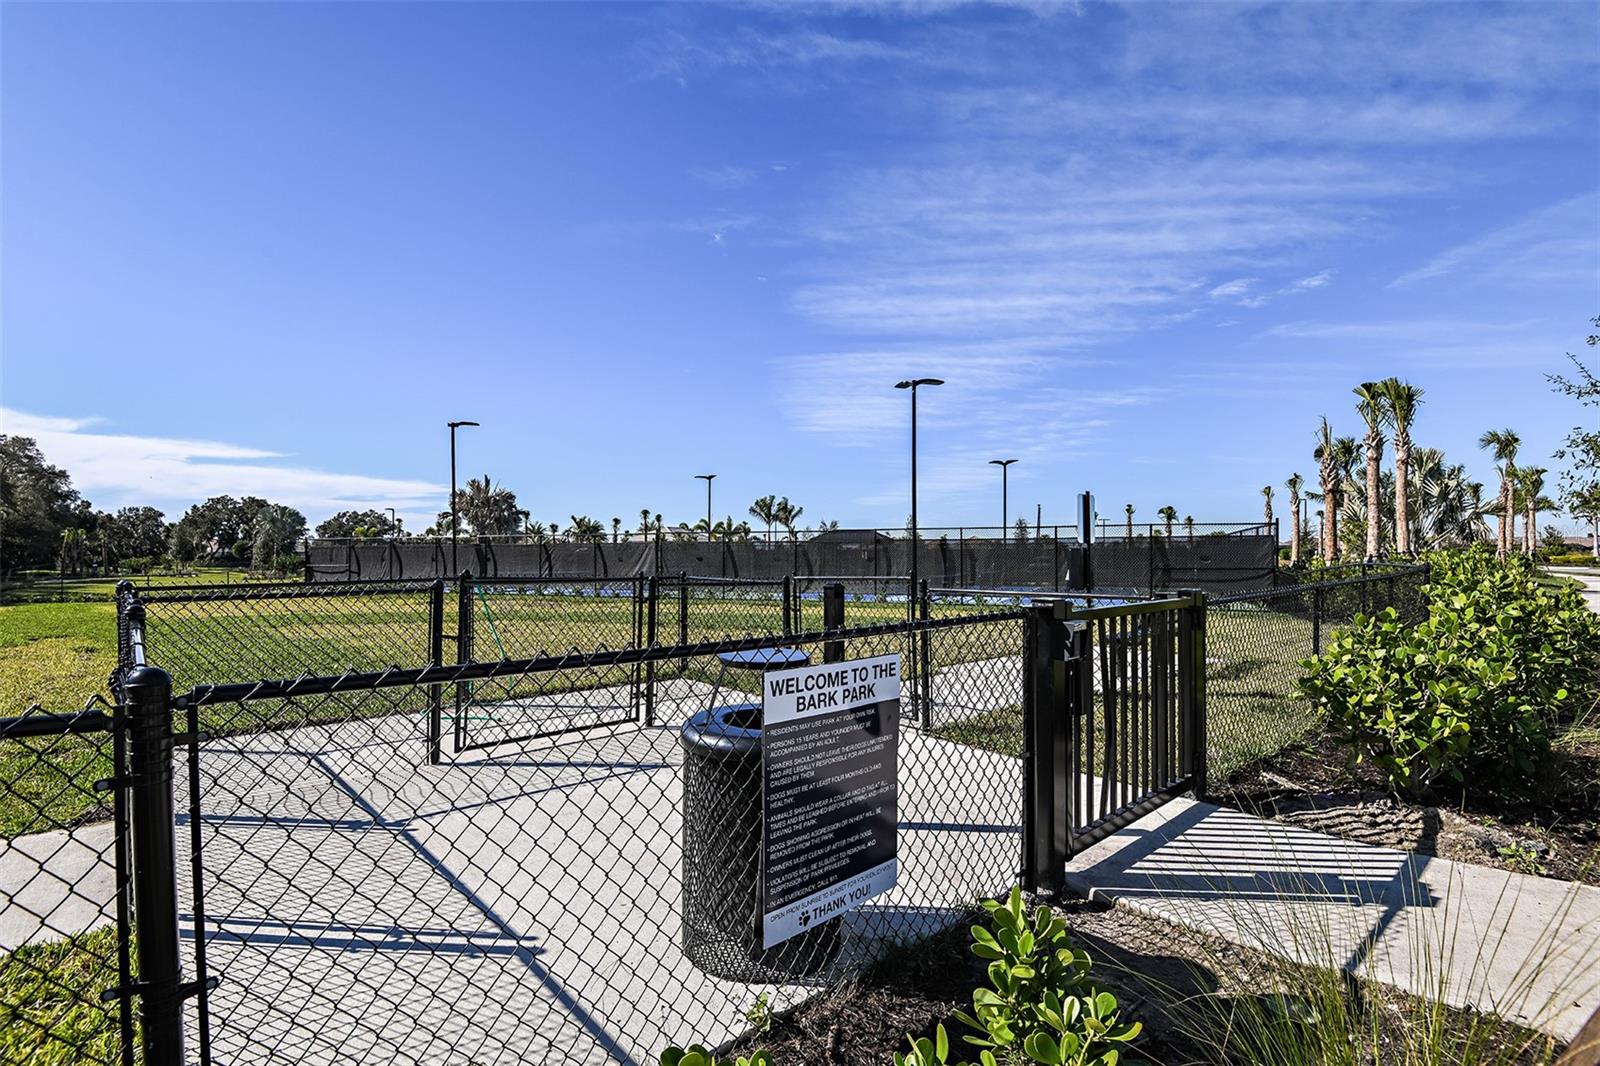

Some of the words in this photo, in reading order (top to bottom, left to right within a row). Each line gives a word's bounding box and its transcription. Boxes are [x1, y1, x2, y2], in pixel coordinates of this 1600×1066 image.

[770, 669, 847, 697] WELCOME
[851, 666, 868, 683] TO
[871, 662, 895, 680] THE
[796, 689, 837, 713] BARK
[842, 683, 875, 703] PARK
[813, 894, 846, 920] THANK
[849, 883, 870, 903] YOU!
